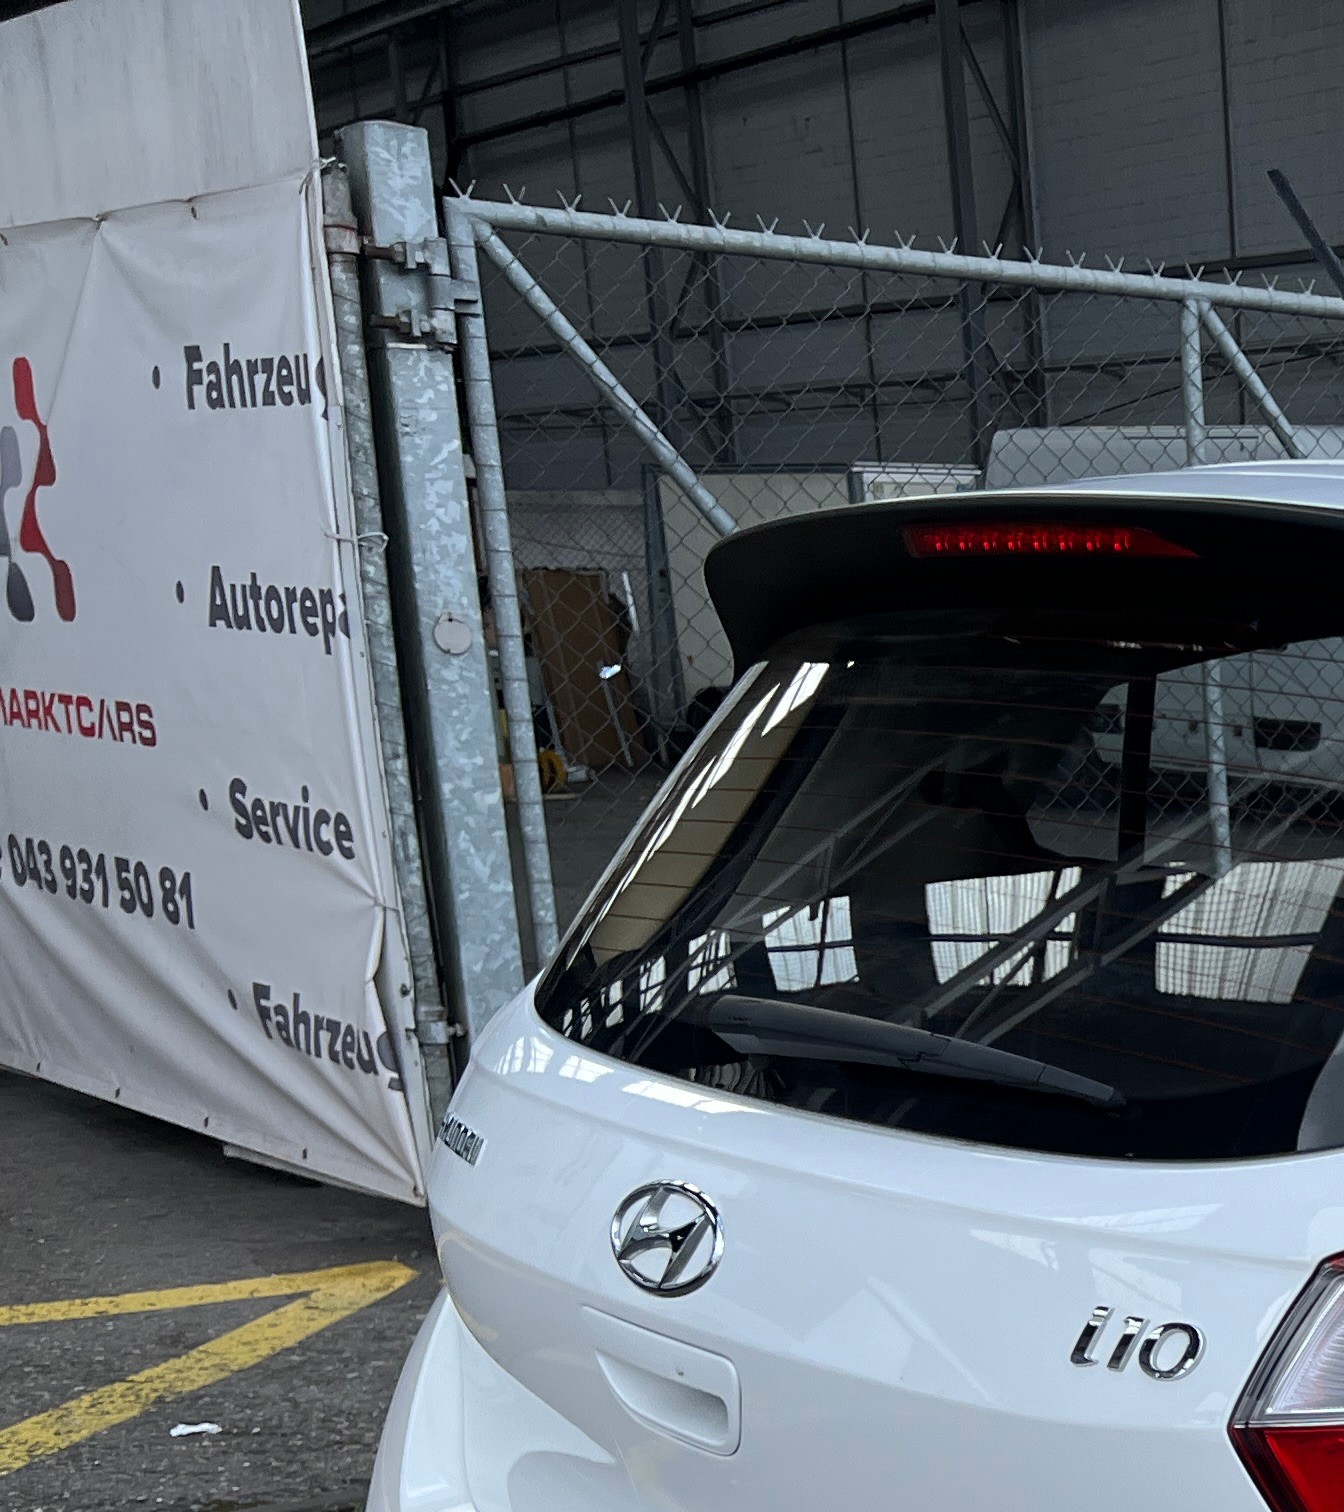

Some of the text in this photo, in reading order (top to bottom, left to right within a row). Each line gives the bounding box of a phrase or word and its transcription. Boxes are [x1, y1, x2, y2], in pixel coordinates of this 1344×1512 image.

[229, 778, 355, 860] Service
[8, 833, 195, 930] 043 931 50 81
[1070, 1305, 1207, 1383] i10
